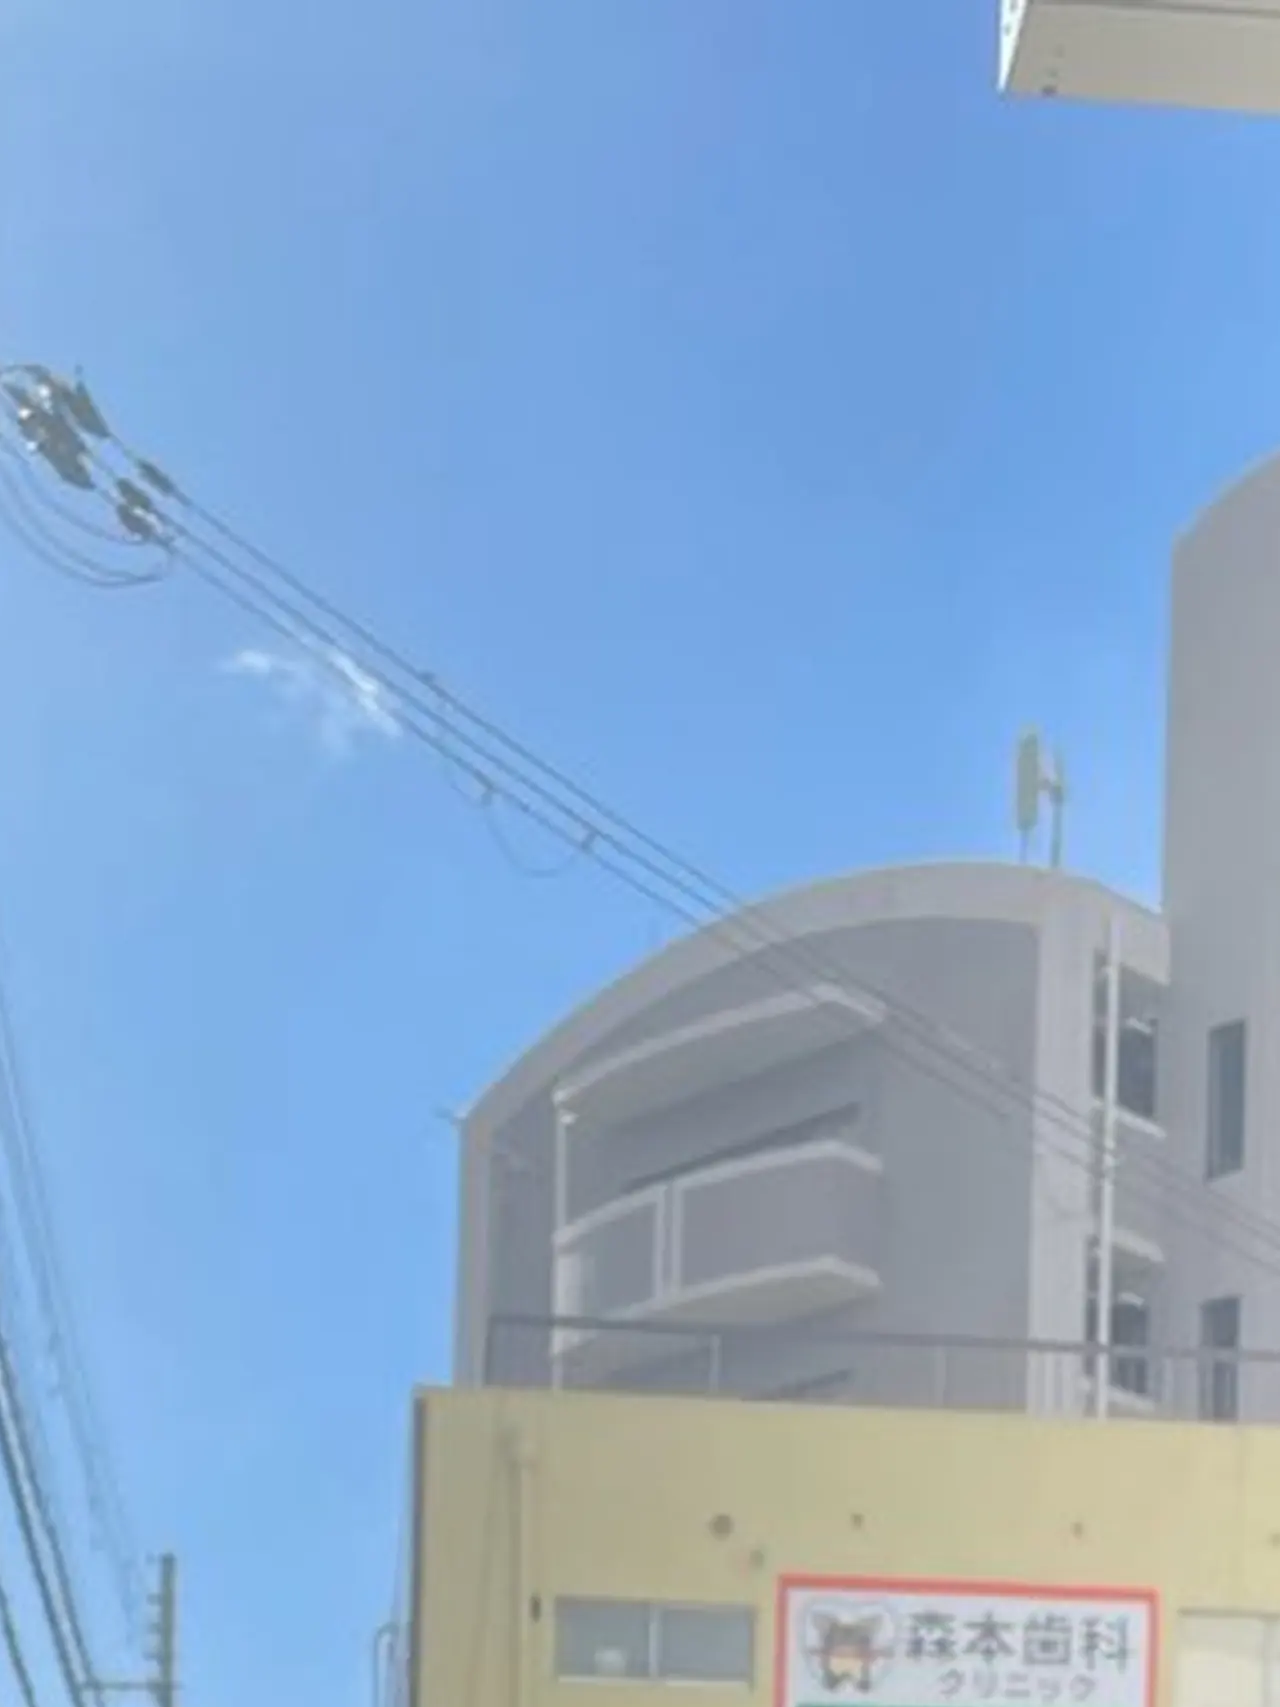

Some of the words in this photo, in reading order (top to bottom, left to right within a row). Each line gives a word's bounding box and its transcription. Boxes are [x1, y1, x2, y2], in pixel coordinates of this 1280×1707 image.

[904, 1609, 1134, 1675] 森本歯科
[938, 1668, 1097, 1703] クリニック
